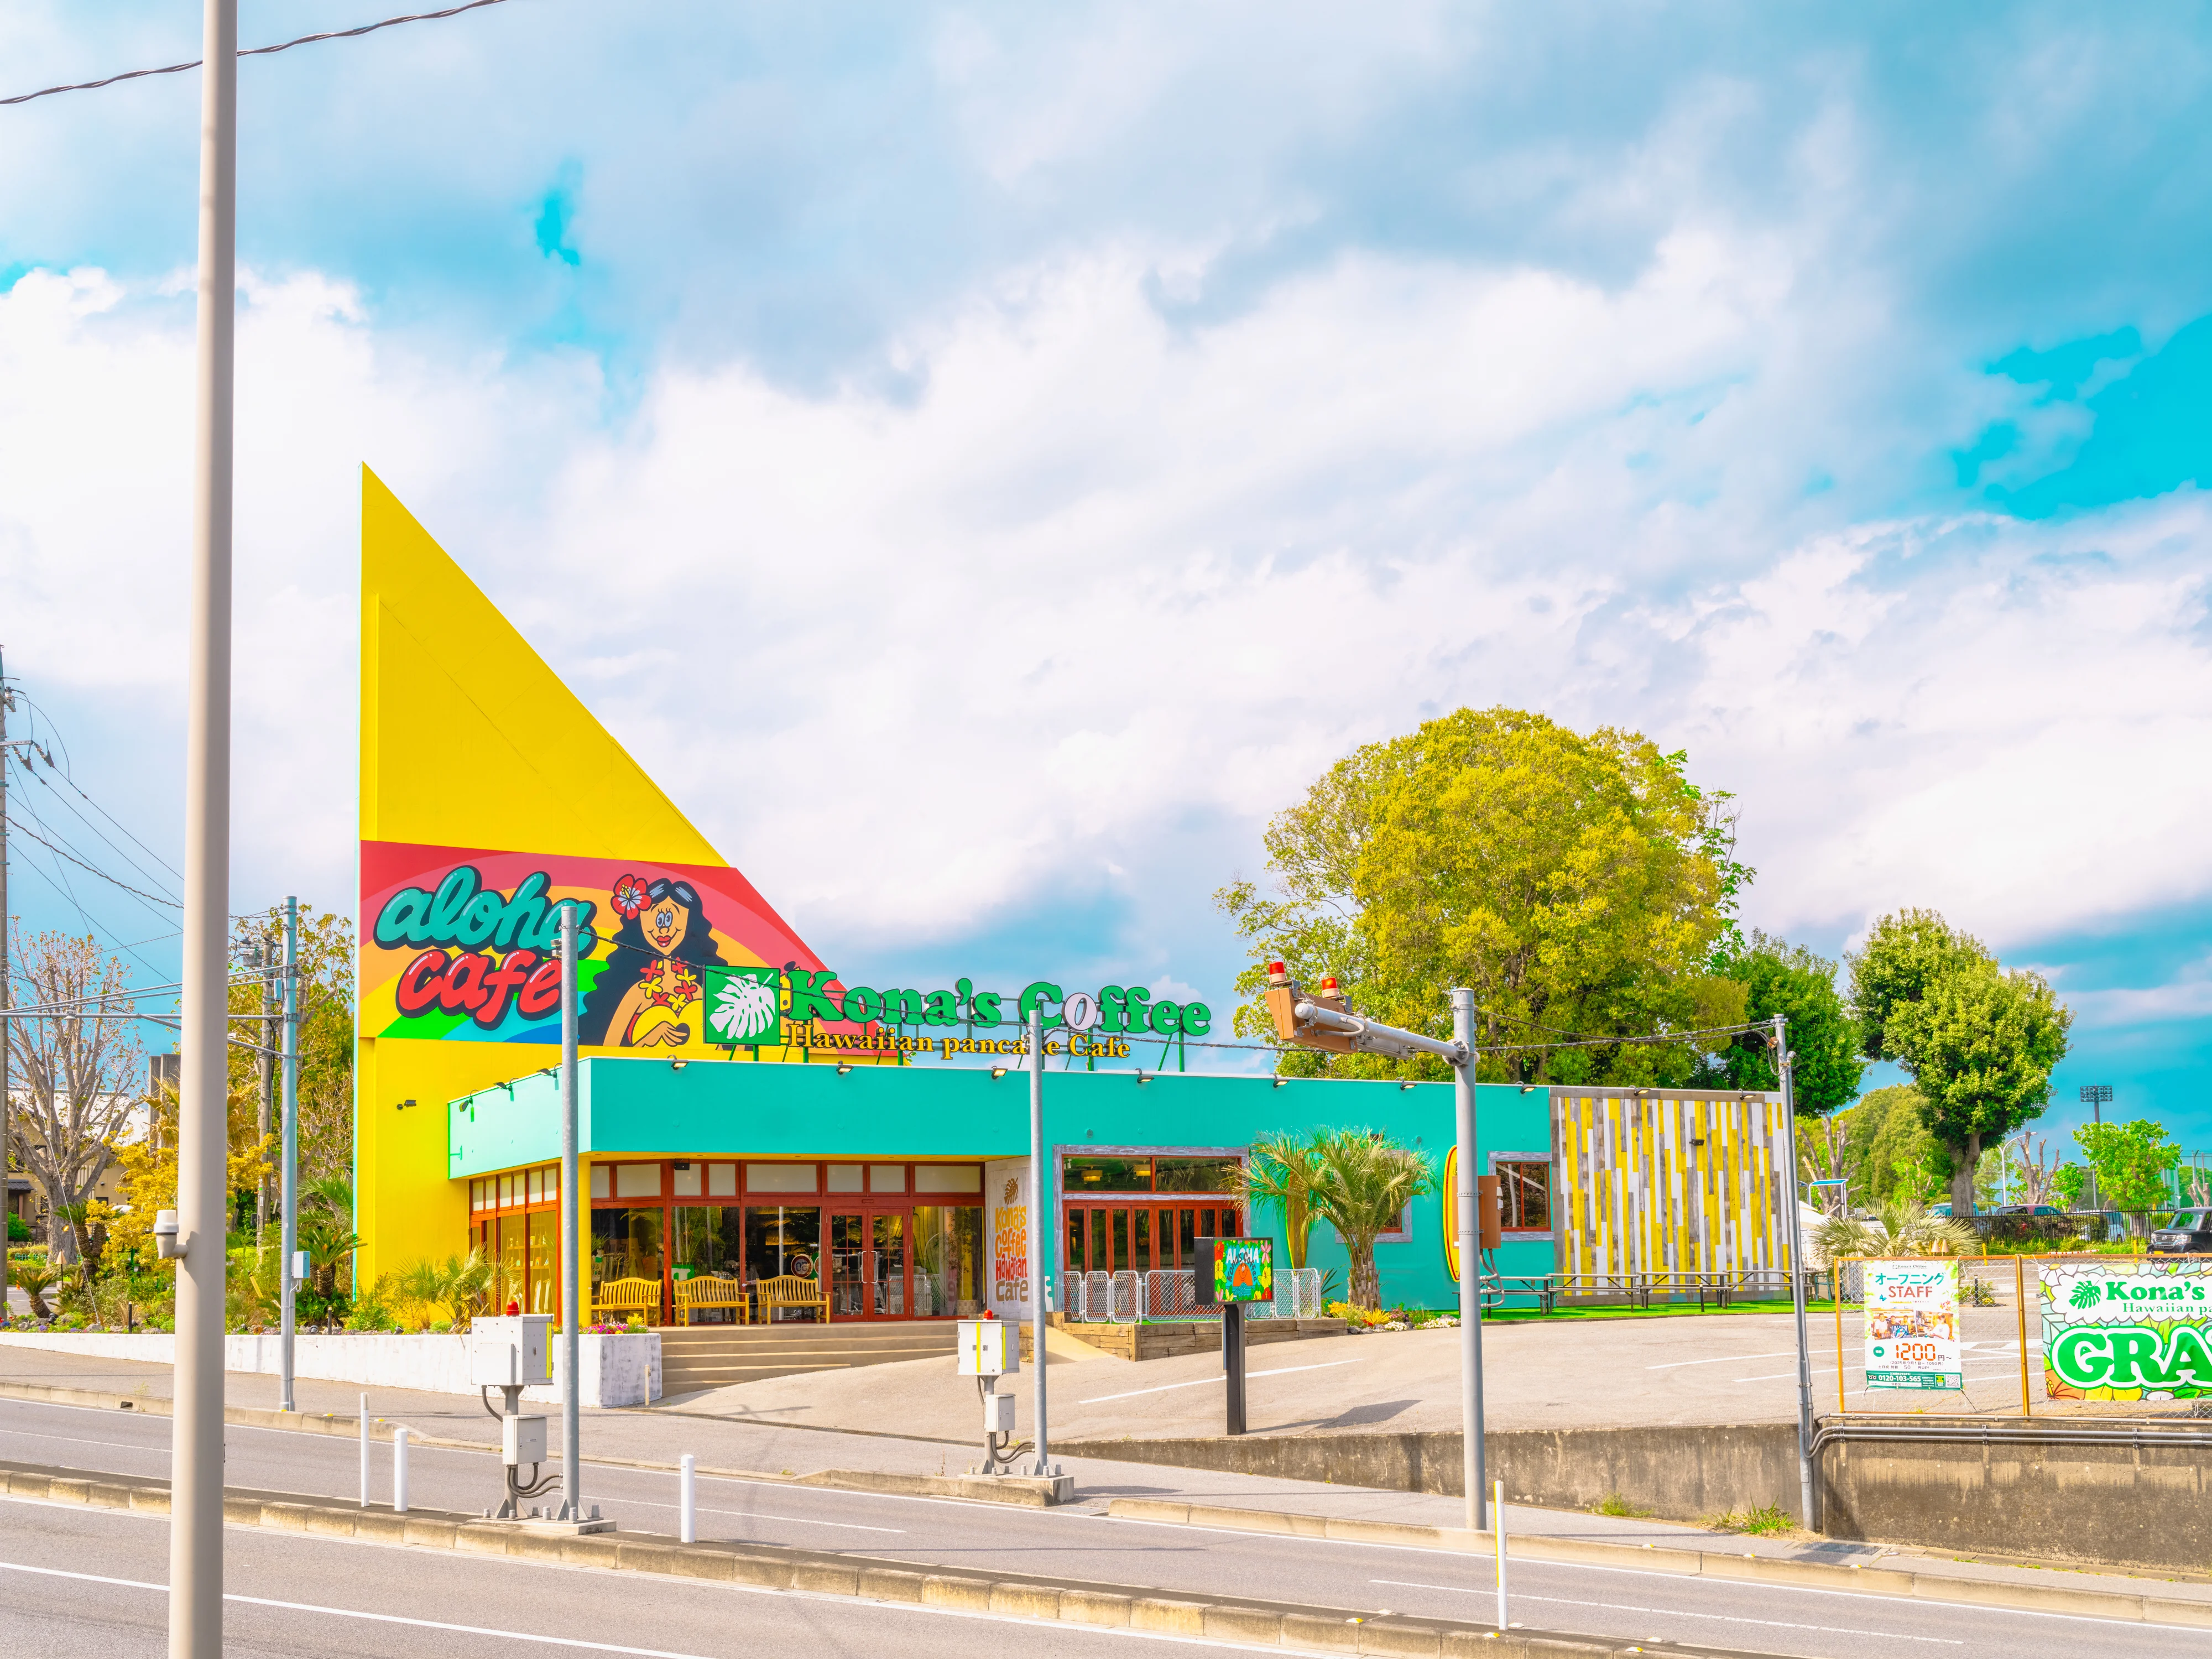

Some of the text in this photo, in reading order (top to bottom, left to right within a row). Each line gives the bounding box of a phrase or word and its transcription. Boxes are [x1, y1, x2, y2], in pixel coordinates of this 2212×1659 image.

[374, 865, 598, 958] aloha
[397, 950, 562, 1027] cafe
[787, 969, 1211, 1036] Kona's Coffee
[786, 1023, 1130, 1060] Hawaiian pancae Cafe
[995, 1205, 1027, 1233] Kona's
[995, 1228, 1026, 1259] Coffee
[1226, 1248, 1259, 1264] ALOHA
[996, 1253, 1027, 1281] Hawaiian
[1875, 1272, 1947, 1285] オープニング
[1888, 1286, 1933, 1298] STAFF
[2105, 1281, 2205, 1300] Kona's
[2122, 1303, 2194, 1312] Hawaiian
[1896, 1343, 1936, 1361] 1200
[2054, 1329, 2212, 1386] GRA
